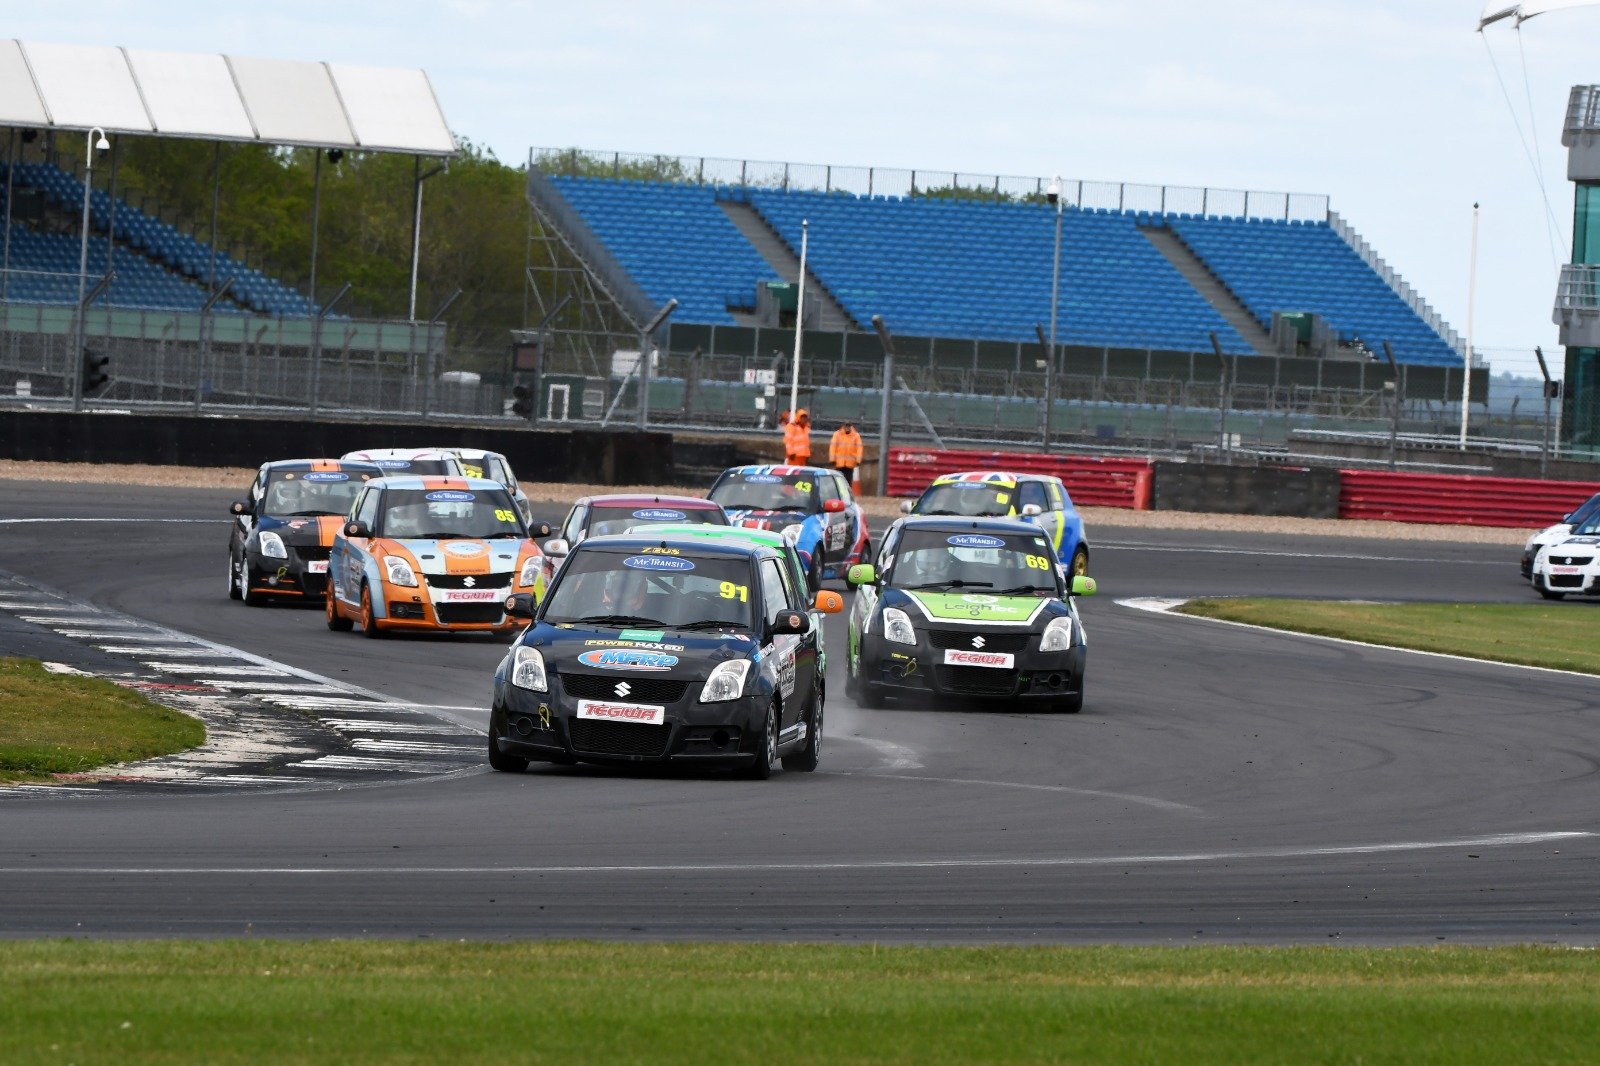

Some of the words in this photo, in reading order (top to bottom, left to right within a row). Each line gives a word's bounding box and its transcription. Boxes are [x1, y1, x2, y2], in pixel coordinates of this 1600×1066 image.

[794, 480, 812, 493] 43
[494, 509, 516, 523] 85
[969, 536, 998, 545] TRANSIT
[649, 557, 685, 568] TRANSIT
[1025, 554, 1049, 571] 69
[719, 581, 748, 603] 91
[586, 639, 634, 648] POWER
[600, 651, 679, 668] MFRP
[949, 651, 1007, 665] TEGIWA
[584, 703, 659, 720] TEGIWA
